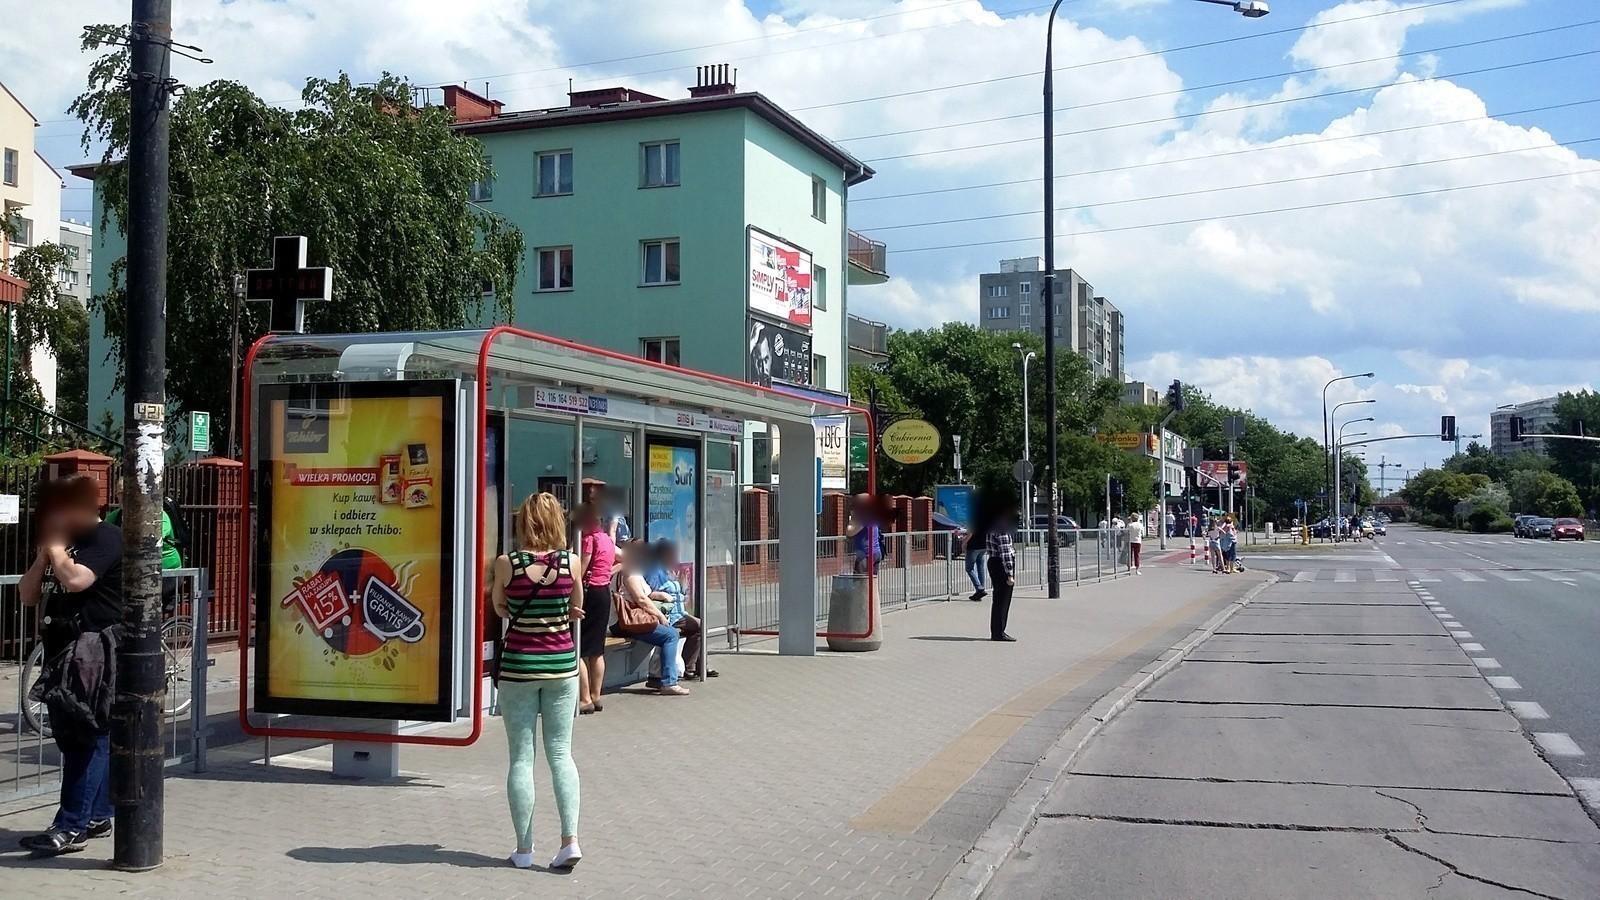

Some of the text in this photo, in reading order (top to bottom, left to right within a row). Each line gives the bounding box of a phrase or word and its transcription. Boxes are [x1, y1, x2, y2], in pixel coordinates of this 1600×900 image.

[569, 395, 578, 406] 519
[824, 426, 841, 449] BFG
[889, 431, 932, 442] Cukiernia
[888, 444, 934, 455] Wiedeńska
[298, 472, 377, 485] WIELKA PROMOCJA
[675, 467, 693, 486] Surf
[332, 492, 376, 505] Kup kawę
[333, 509, 377, 521] i odbierz
[309, 524, 403, 537] w sklepach Tchibo:
[301, 575, 324, 595] RABAT
[304, 576, 334, 600] NA ZAKUPY
[313, 592, 339, 620] 15%
[369, 588, 413, 624] FILIŻANKA KAWY
[369, 599, 404, 630] GRATIS
